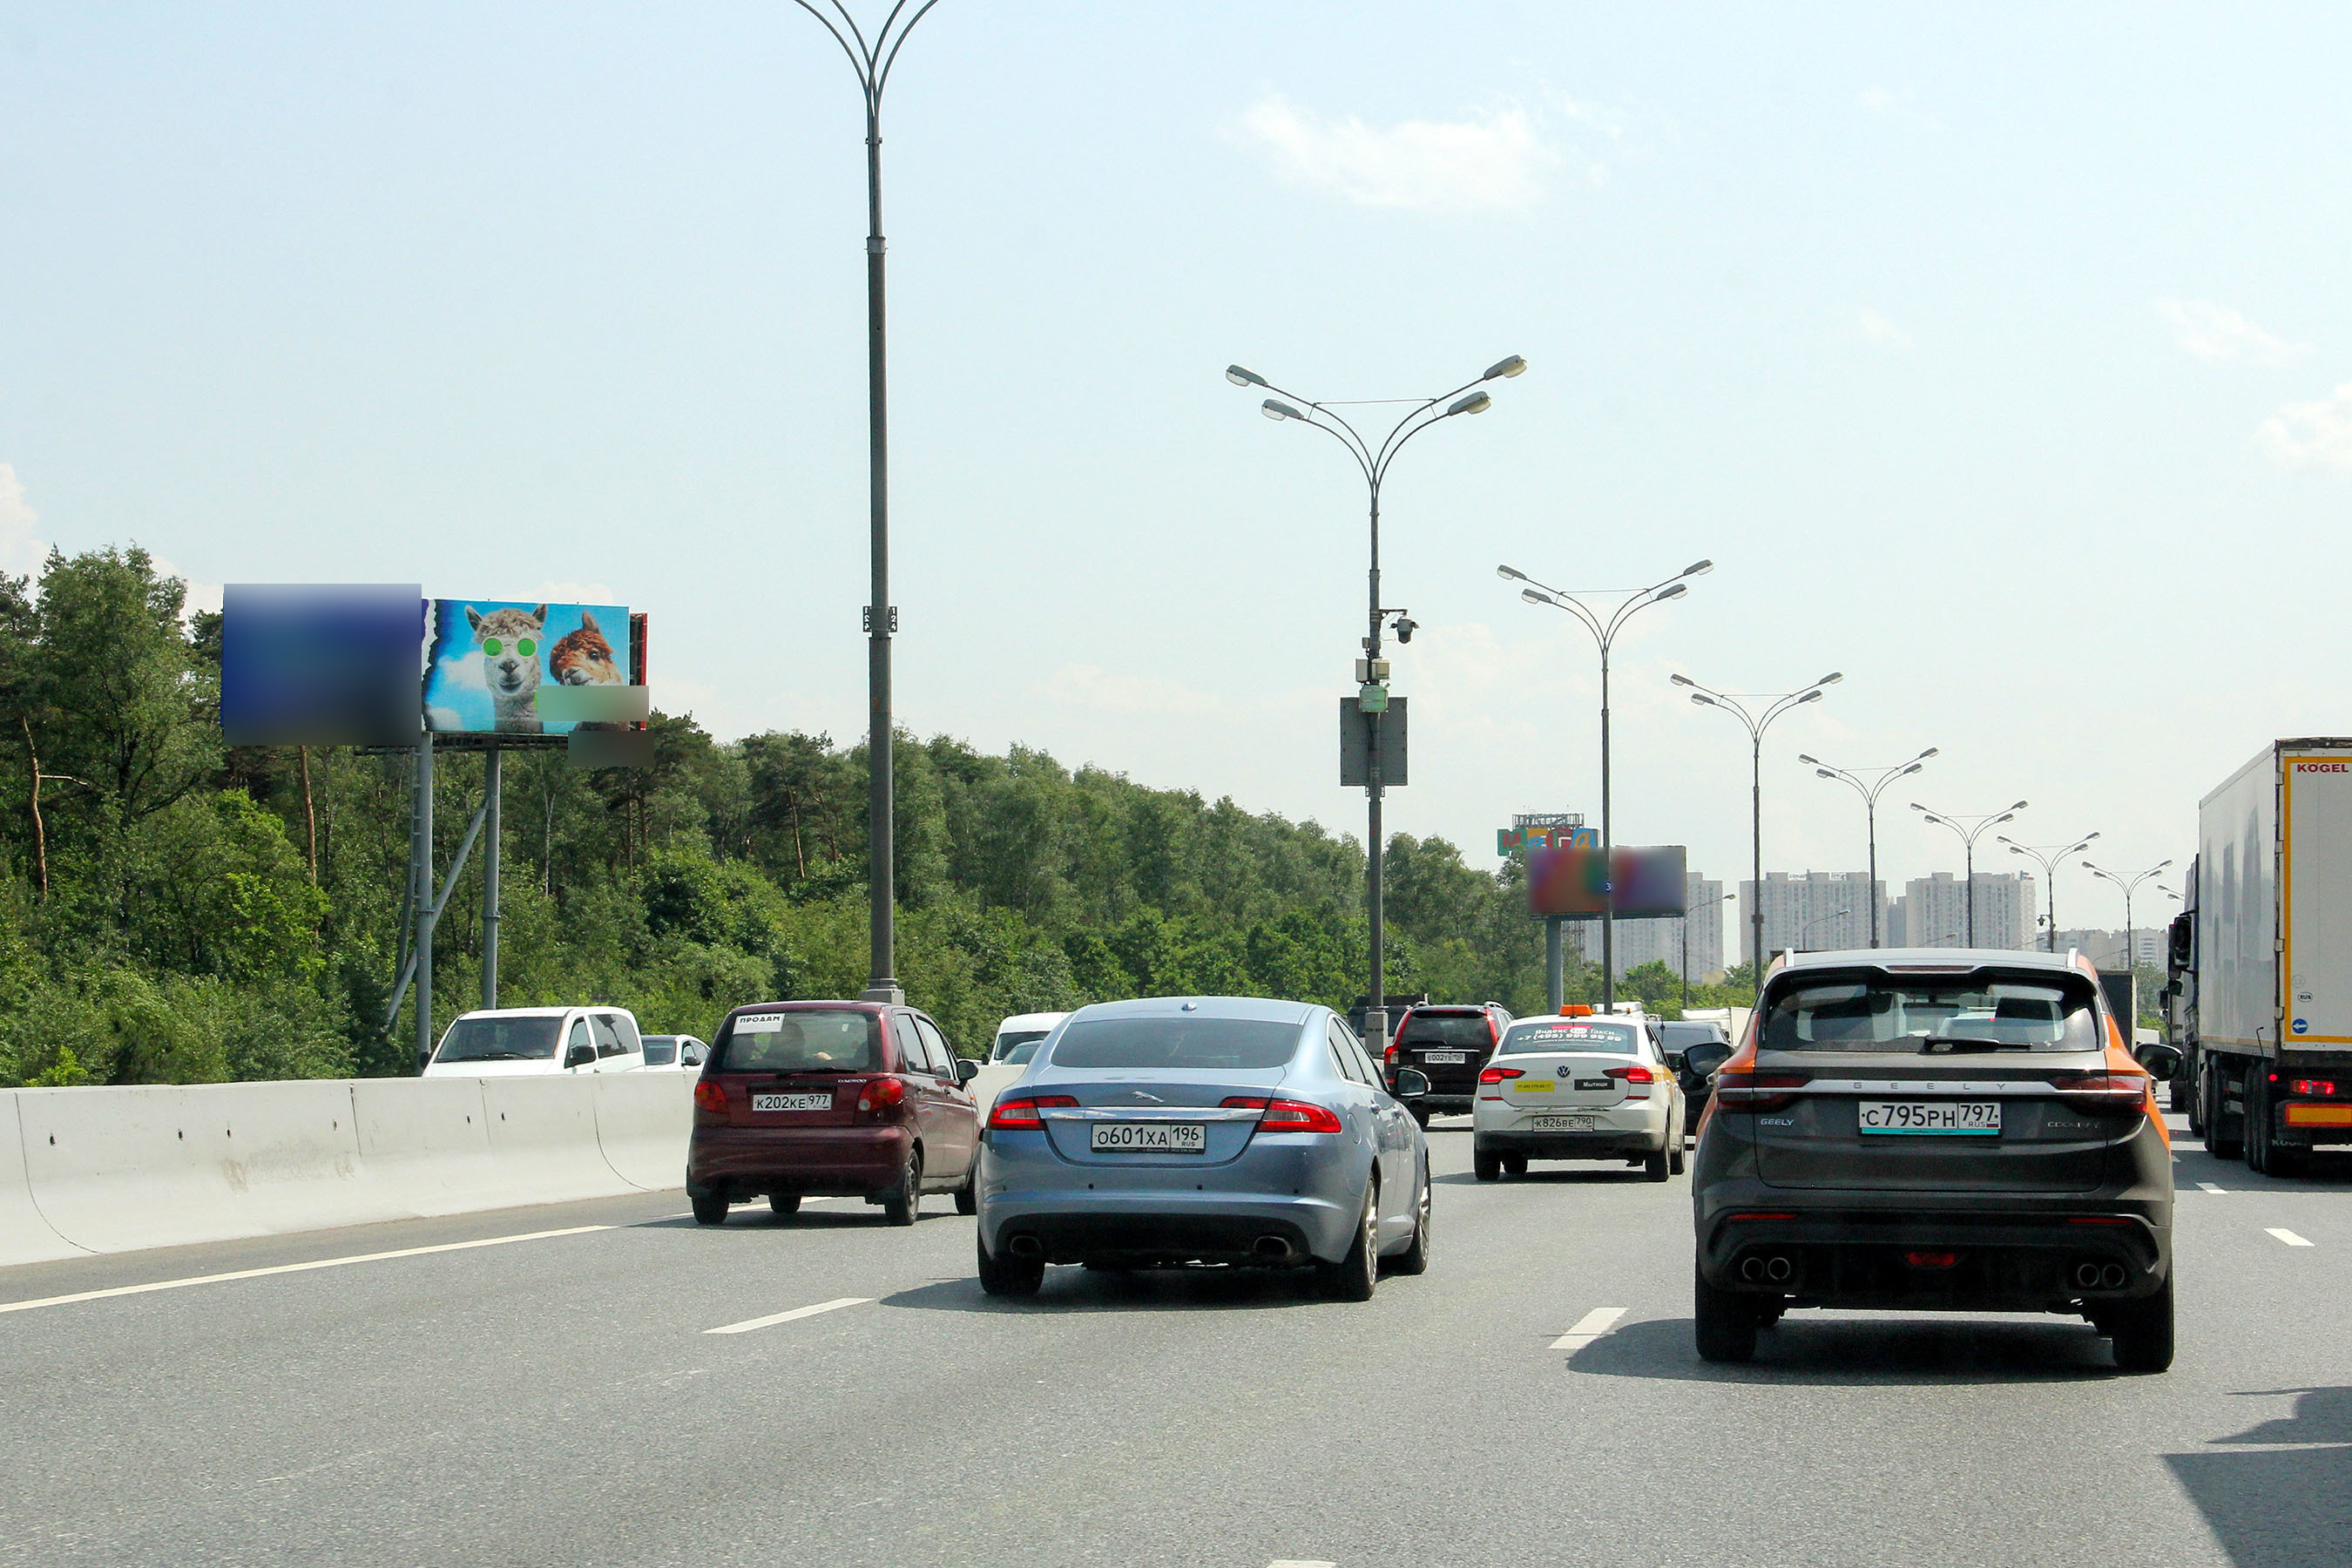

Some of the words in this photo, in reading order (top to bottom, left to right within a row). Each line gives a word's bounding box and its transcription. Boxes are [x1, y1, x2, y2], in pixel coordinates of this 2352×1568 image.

[756, 1096, 807, 1109] К202КЕ
[808, 1095, 828, 1105] 977
[1535, 1118, 1574, 1128] К826ВЕ
[1761, 1118, 1794, 1126] GEELY
[1866, 1105, 1956, 1127] С795РН
[1960, 1105, 1995, 1122] 797
[1098, 1126, 1168, 1146] О601ХА
[1173, 1126, 1200, 1141] 196
